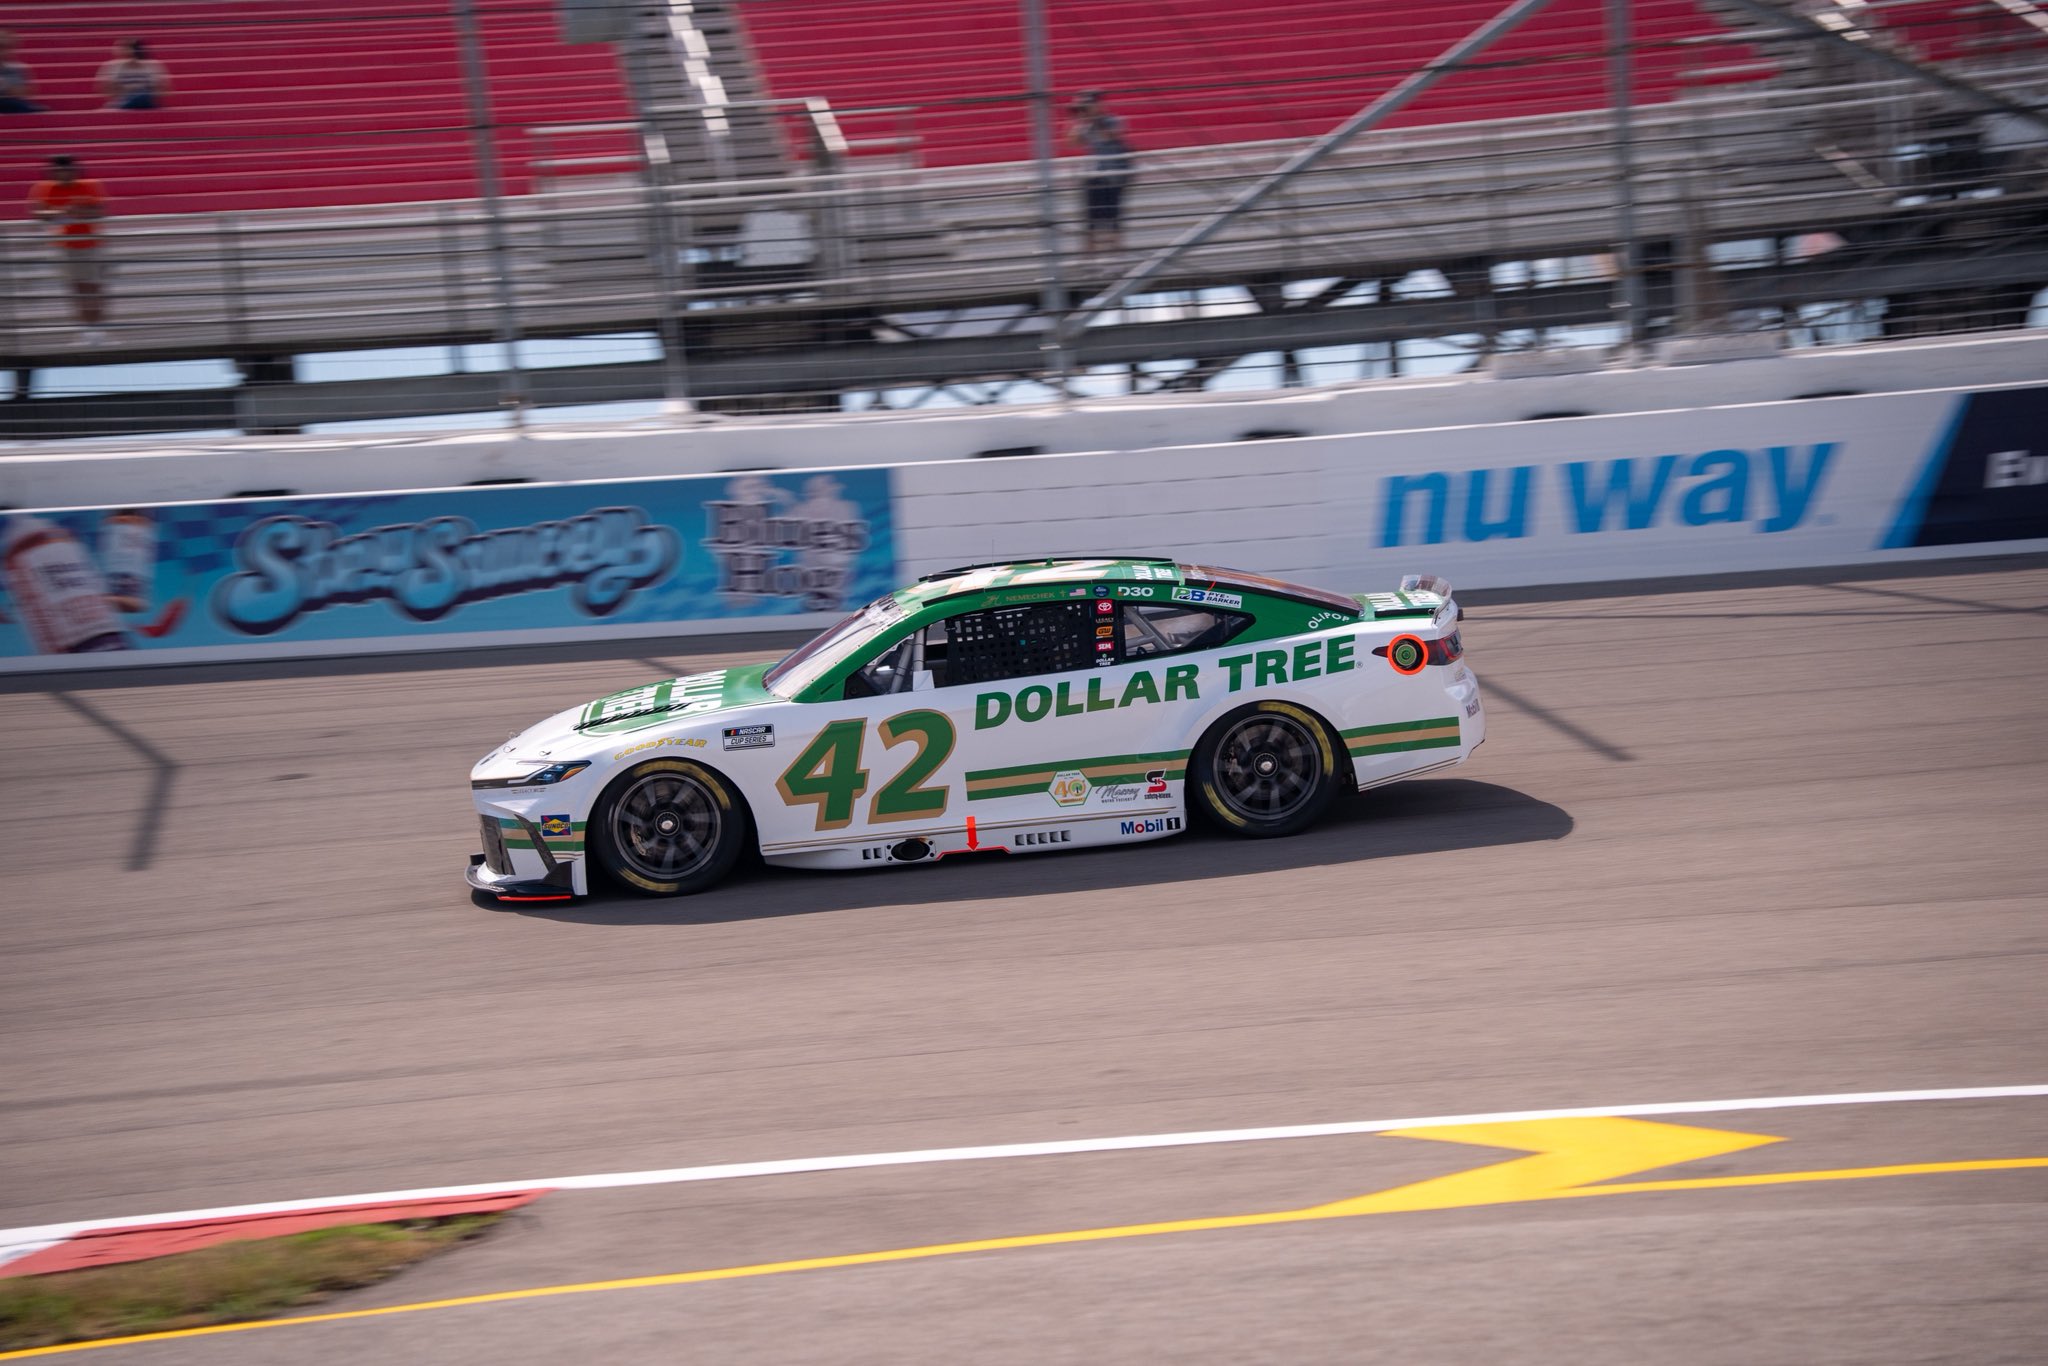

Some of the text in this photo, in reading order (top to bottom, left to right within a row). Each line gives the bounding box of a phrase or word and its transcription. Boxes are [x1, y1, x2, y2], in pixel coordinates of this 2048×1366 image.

[1375, 441, 1843, 548] nu way
[1006, 591, 1055, 601] NEMECHEK
[1206, 596, 1241, 606] BARKER
[1308, 612, 1350, 629] OLIPOP
[974, 634, 1356, 731] DOLLAR TREE
[739, 727, 767, 736] NASCAR
[731, 735, 767, 745] CUP SERIES
[614, 736, 708, 761] GOODYEAR
[775, 708, 957, 832] 42
[543, 822, 571, 831] SUNOCO
[1121, 819, 1163, 834] Mobil
